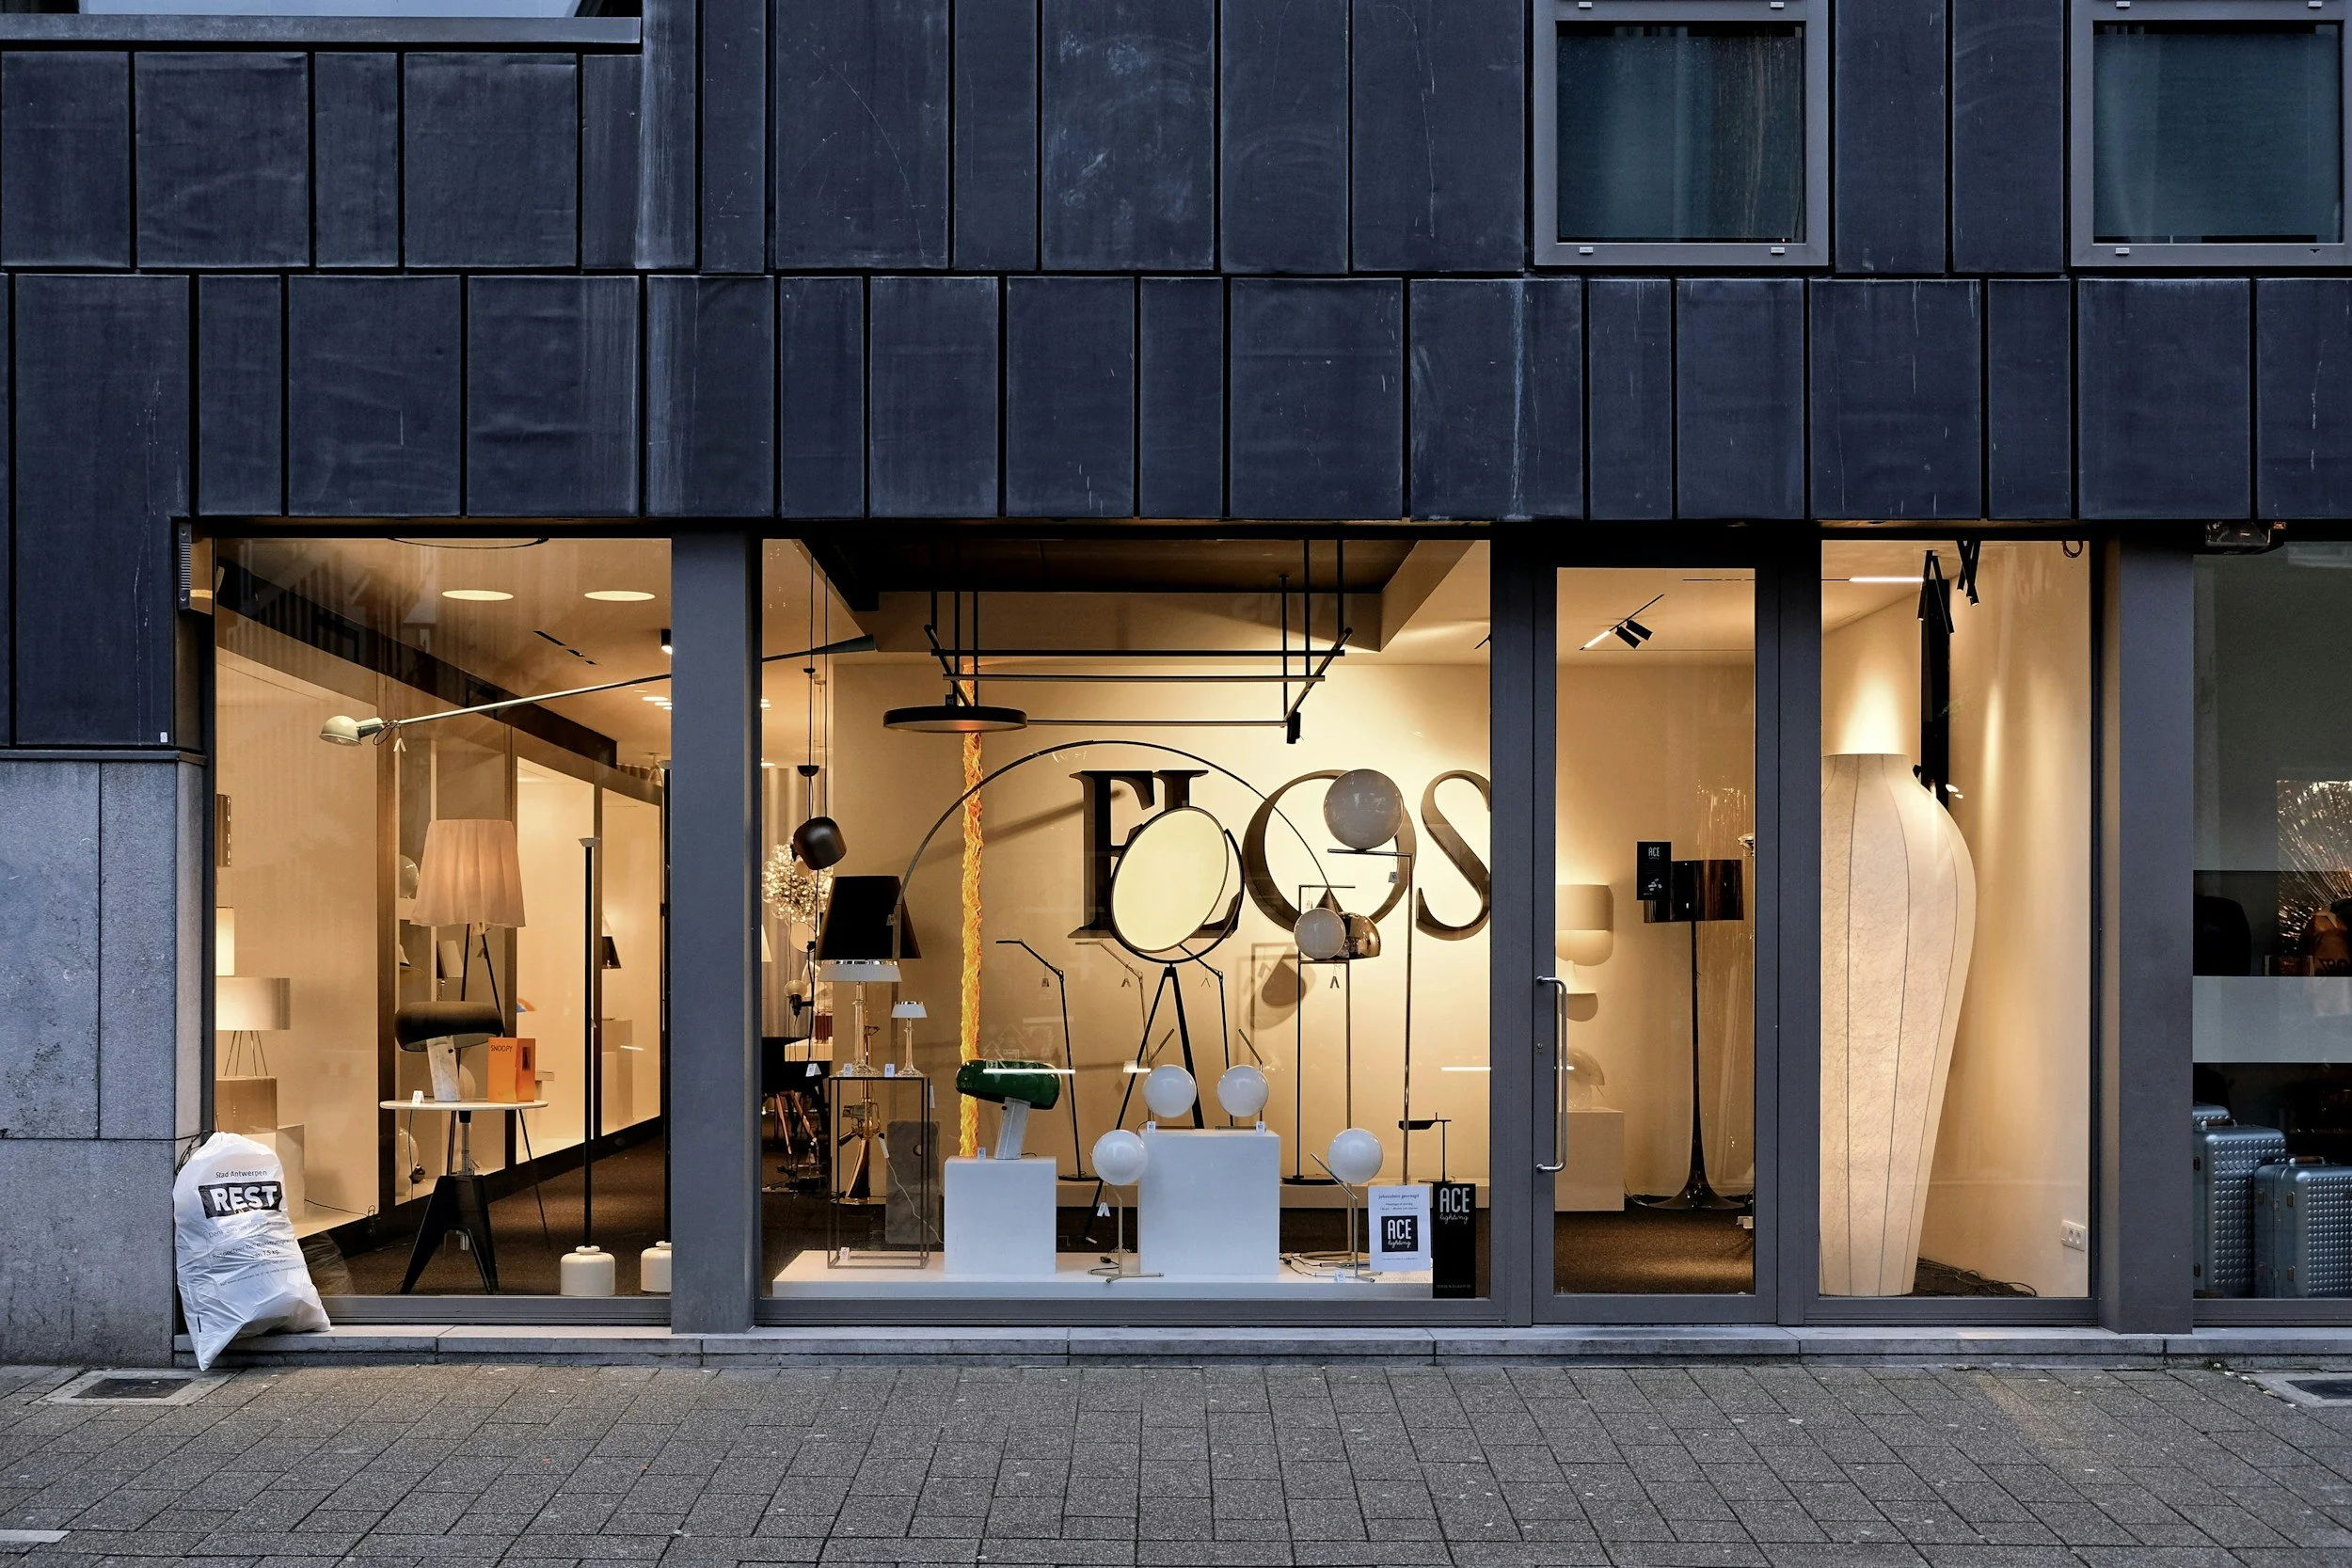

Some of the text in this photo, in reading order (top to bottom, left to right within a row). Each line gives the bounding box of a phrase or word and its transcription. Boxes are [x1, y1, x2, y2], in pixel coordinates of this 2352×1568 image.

[1648, 847, 1661, 857] ACE
[490, 1044, 513, 1053] SNOOPY
[230, 1169, 267, 1178] Antwerpen
[209, 1185, 278, 1212] REST
[1439, 1187, 1470, 1213] ACE
[1387, 1219, 1411, 1240] ACE
